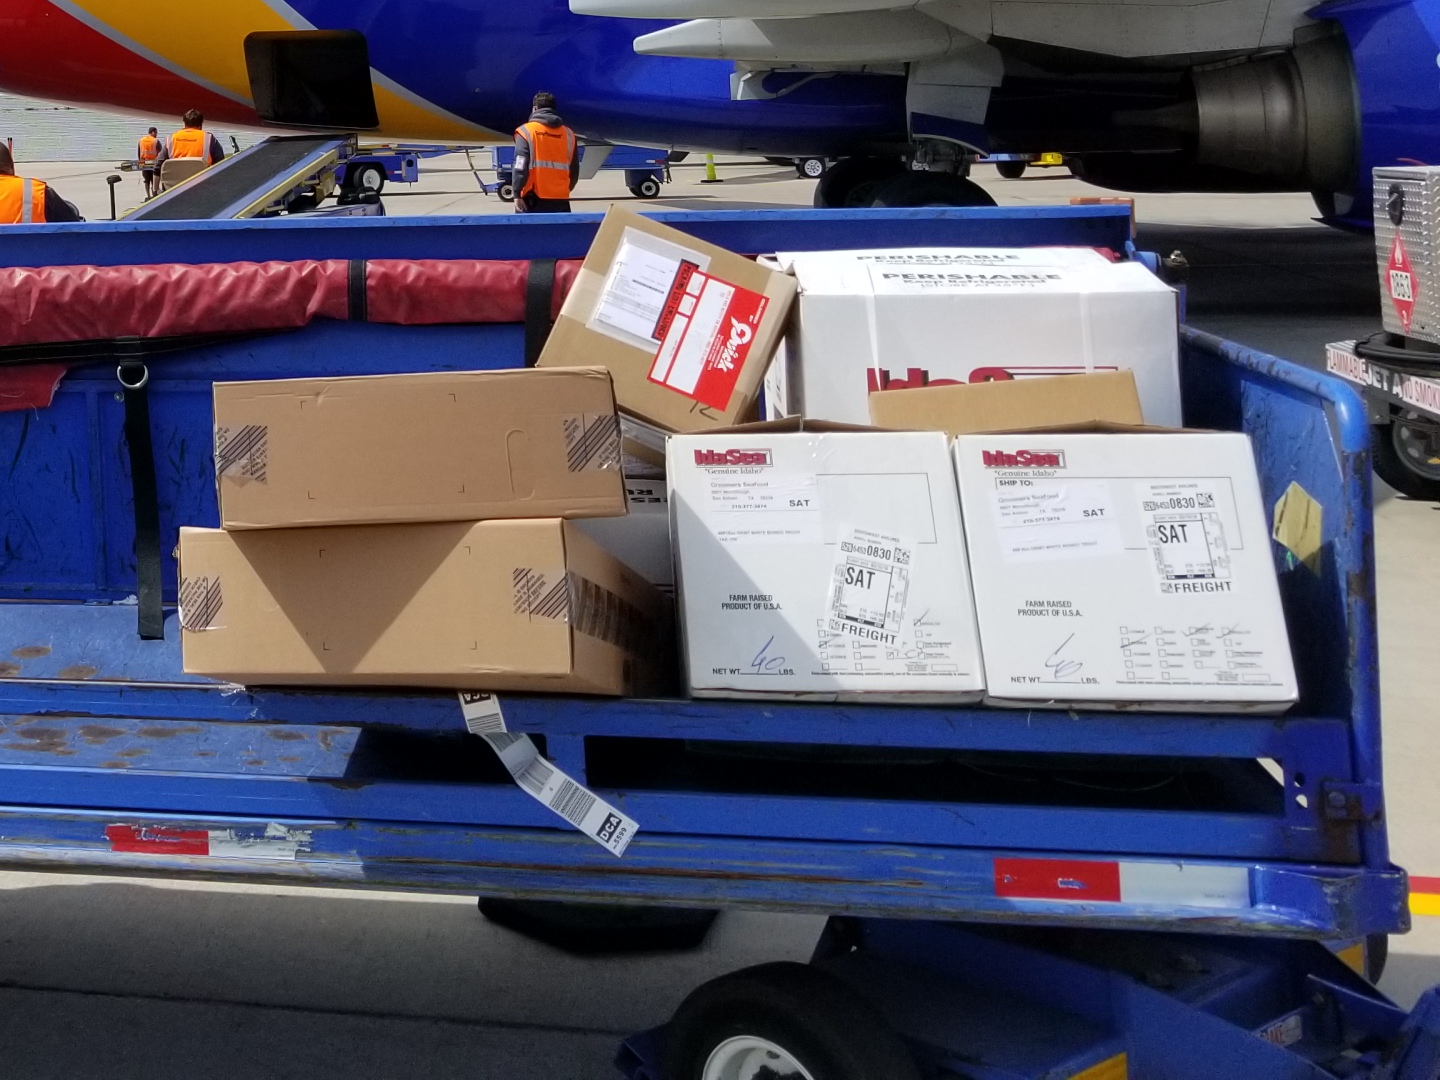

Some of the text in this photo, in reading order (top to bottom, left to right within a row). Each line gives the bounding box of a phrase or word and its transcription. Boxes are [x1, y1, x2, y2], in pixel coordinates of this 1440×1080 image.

[717, 316, 751, 373] Quick
[1363, 363, 1389, 392] JET
[1392, 373, 1403, 398] A
[694, 448, 768, 466] IdaSea
[982, 449, 1061, 467] IdaSea
[789, 499, 811, 508] SAT
[1082, 508, 1106, 518] SAT
[1157, 524, 1188, 544] SAT
[845, 566, 876, 590] SAT
[1174, 581, 1232, 593] FREIGHT
[729, 594, 773, 602] FARM RAISED
[1025, 600, 1072, 608] FARM RAISED
[1062, 609, 1084, 617] U.S.A.
[841, 622, 898, 646] FREIGHT
[1080, 677, 1100, 685] LBS.
[597, 815, 622, 842] DCA
